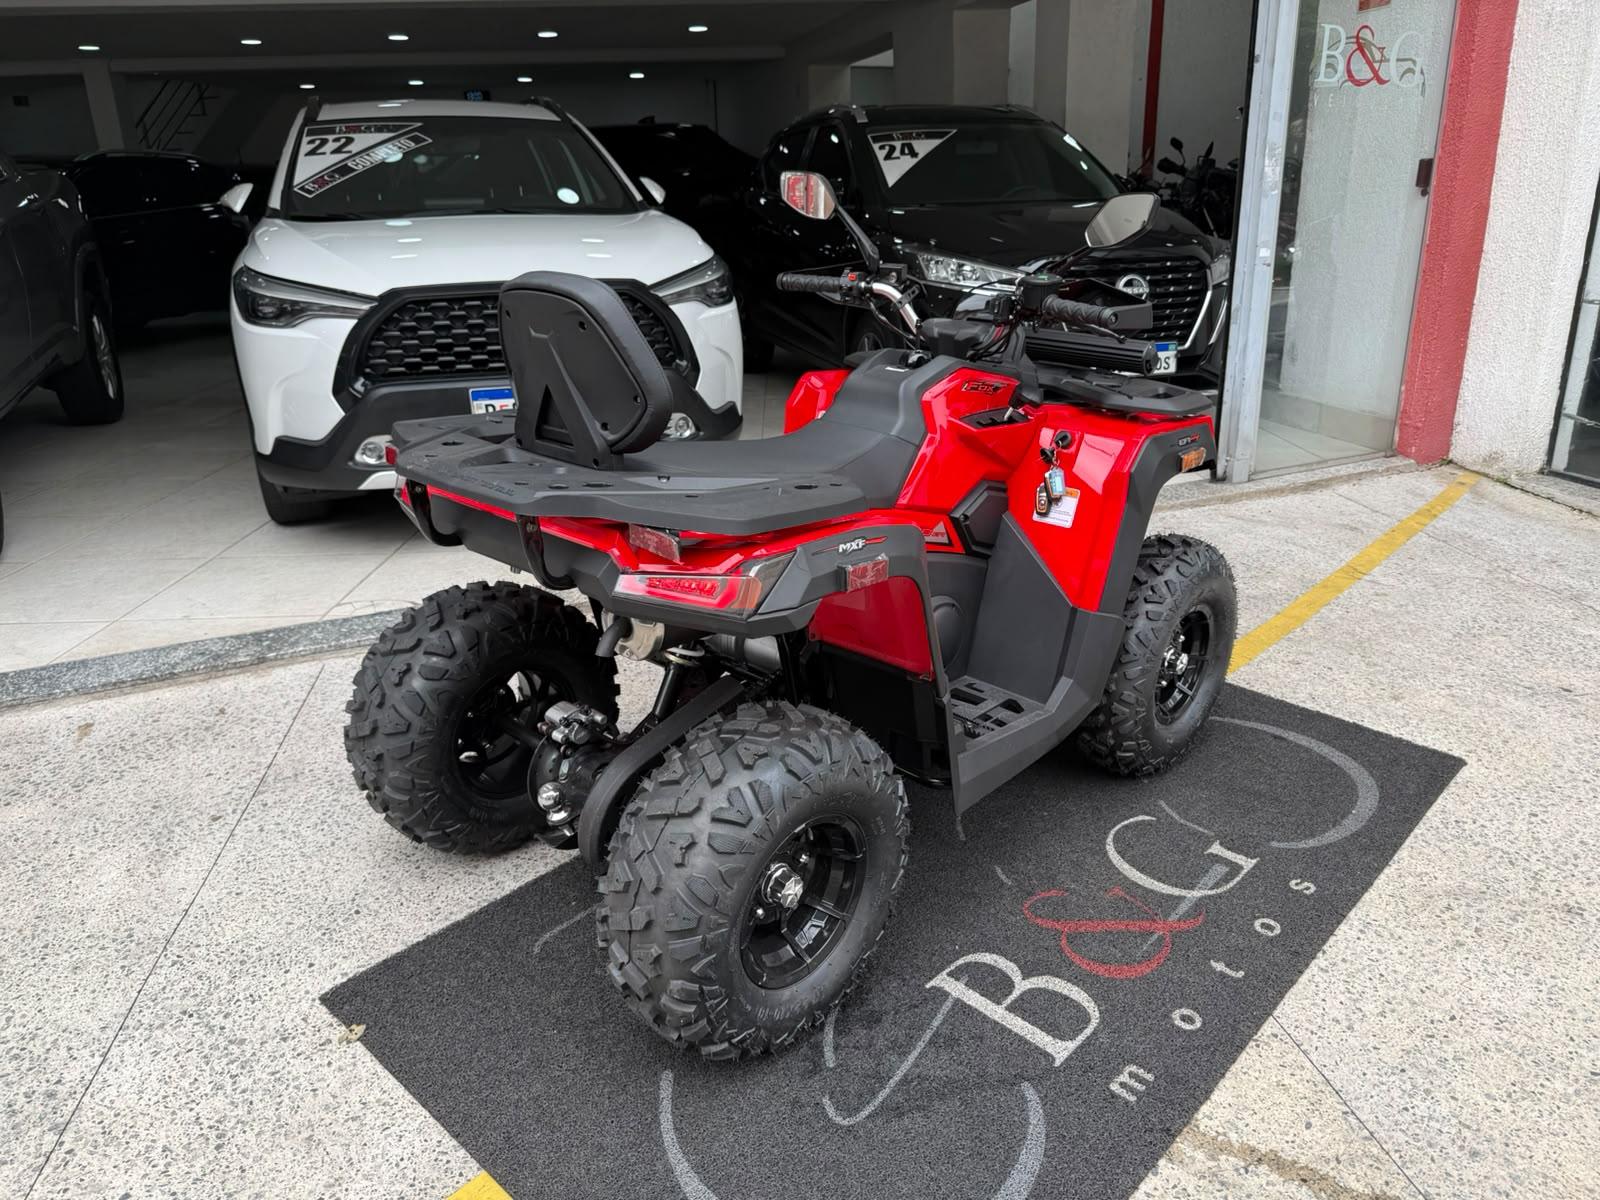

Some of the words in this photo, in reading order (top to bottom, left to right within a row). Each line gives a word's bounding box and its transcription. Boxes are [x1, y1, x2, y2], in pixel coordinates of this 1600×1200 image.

[1313, 23, 1424, 87] B&G
[304, 136, 355, 157] 22
[878, 142, 920, 161] 24
[838, 538, 866, 553] MXF
[1109, 877, 1317, 1102] motos
